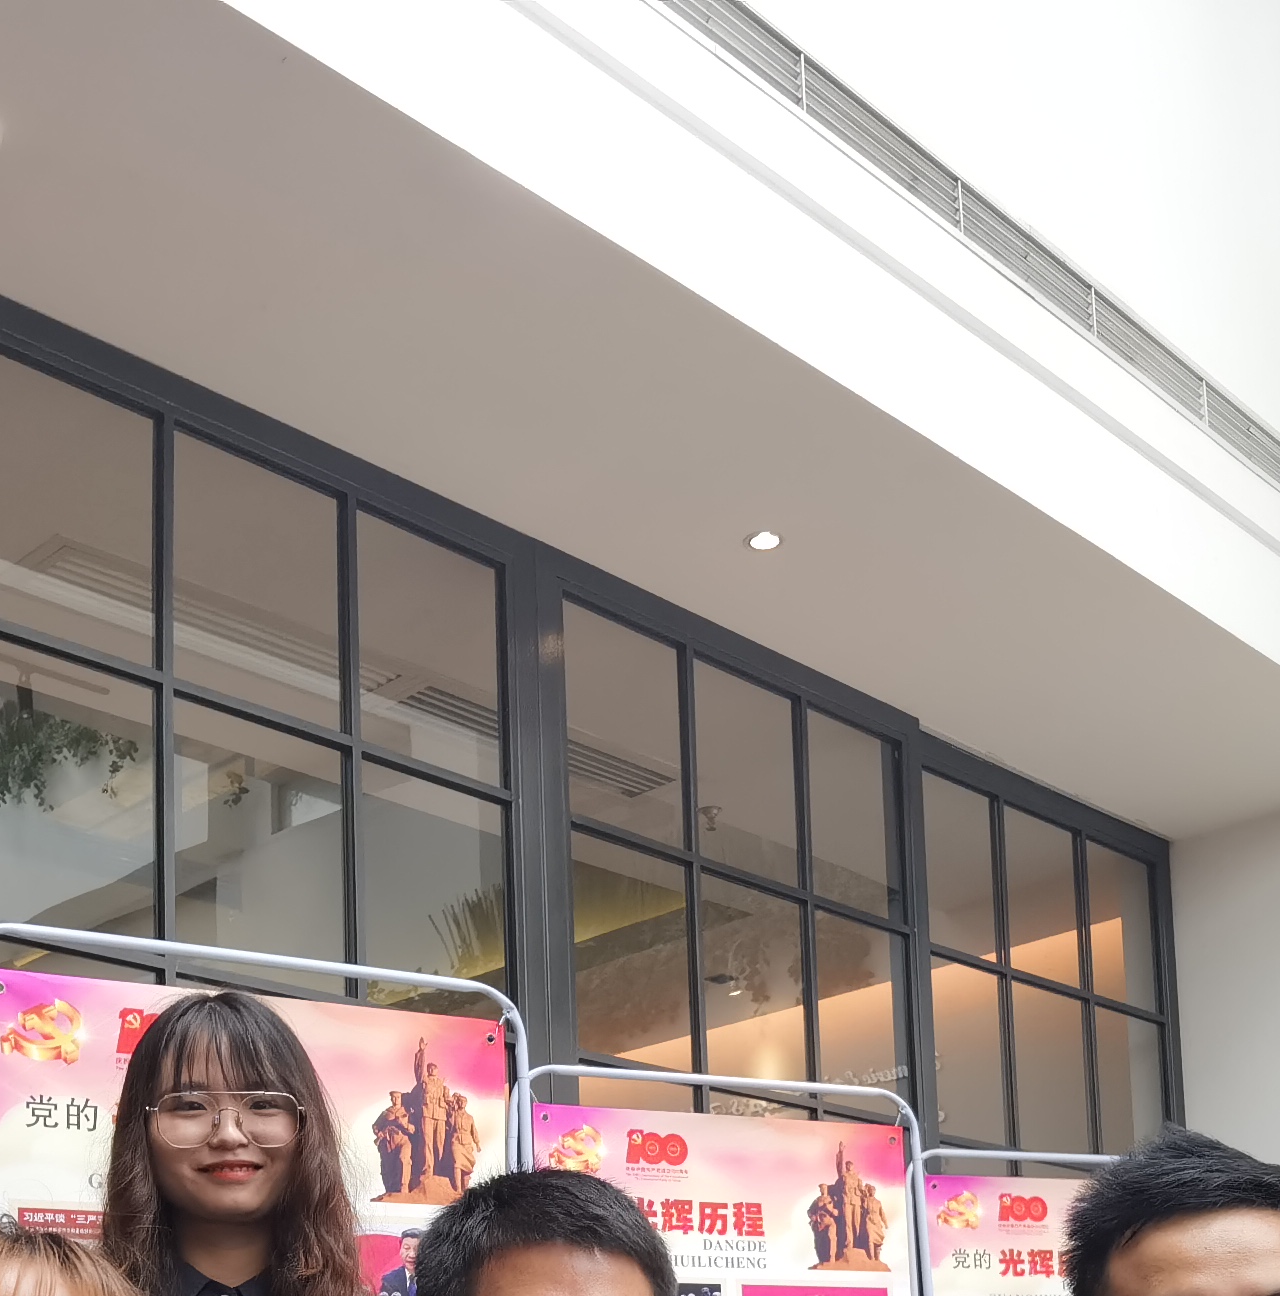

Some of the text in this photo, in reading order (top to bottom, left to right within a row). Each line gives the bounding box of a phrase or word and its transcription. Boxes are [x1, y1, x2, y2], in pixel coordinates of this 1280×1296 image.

[25, 1094, 99, 1132] 党的
[703, 1238, 767, 1253] DANGDE
[951, 1247, 992, 1271] 党的
